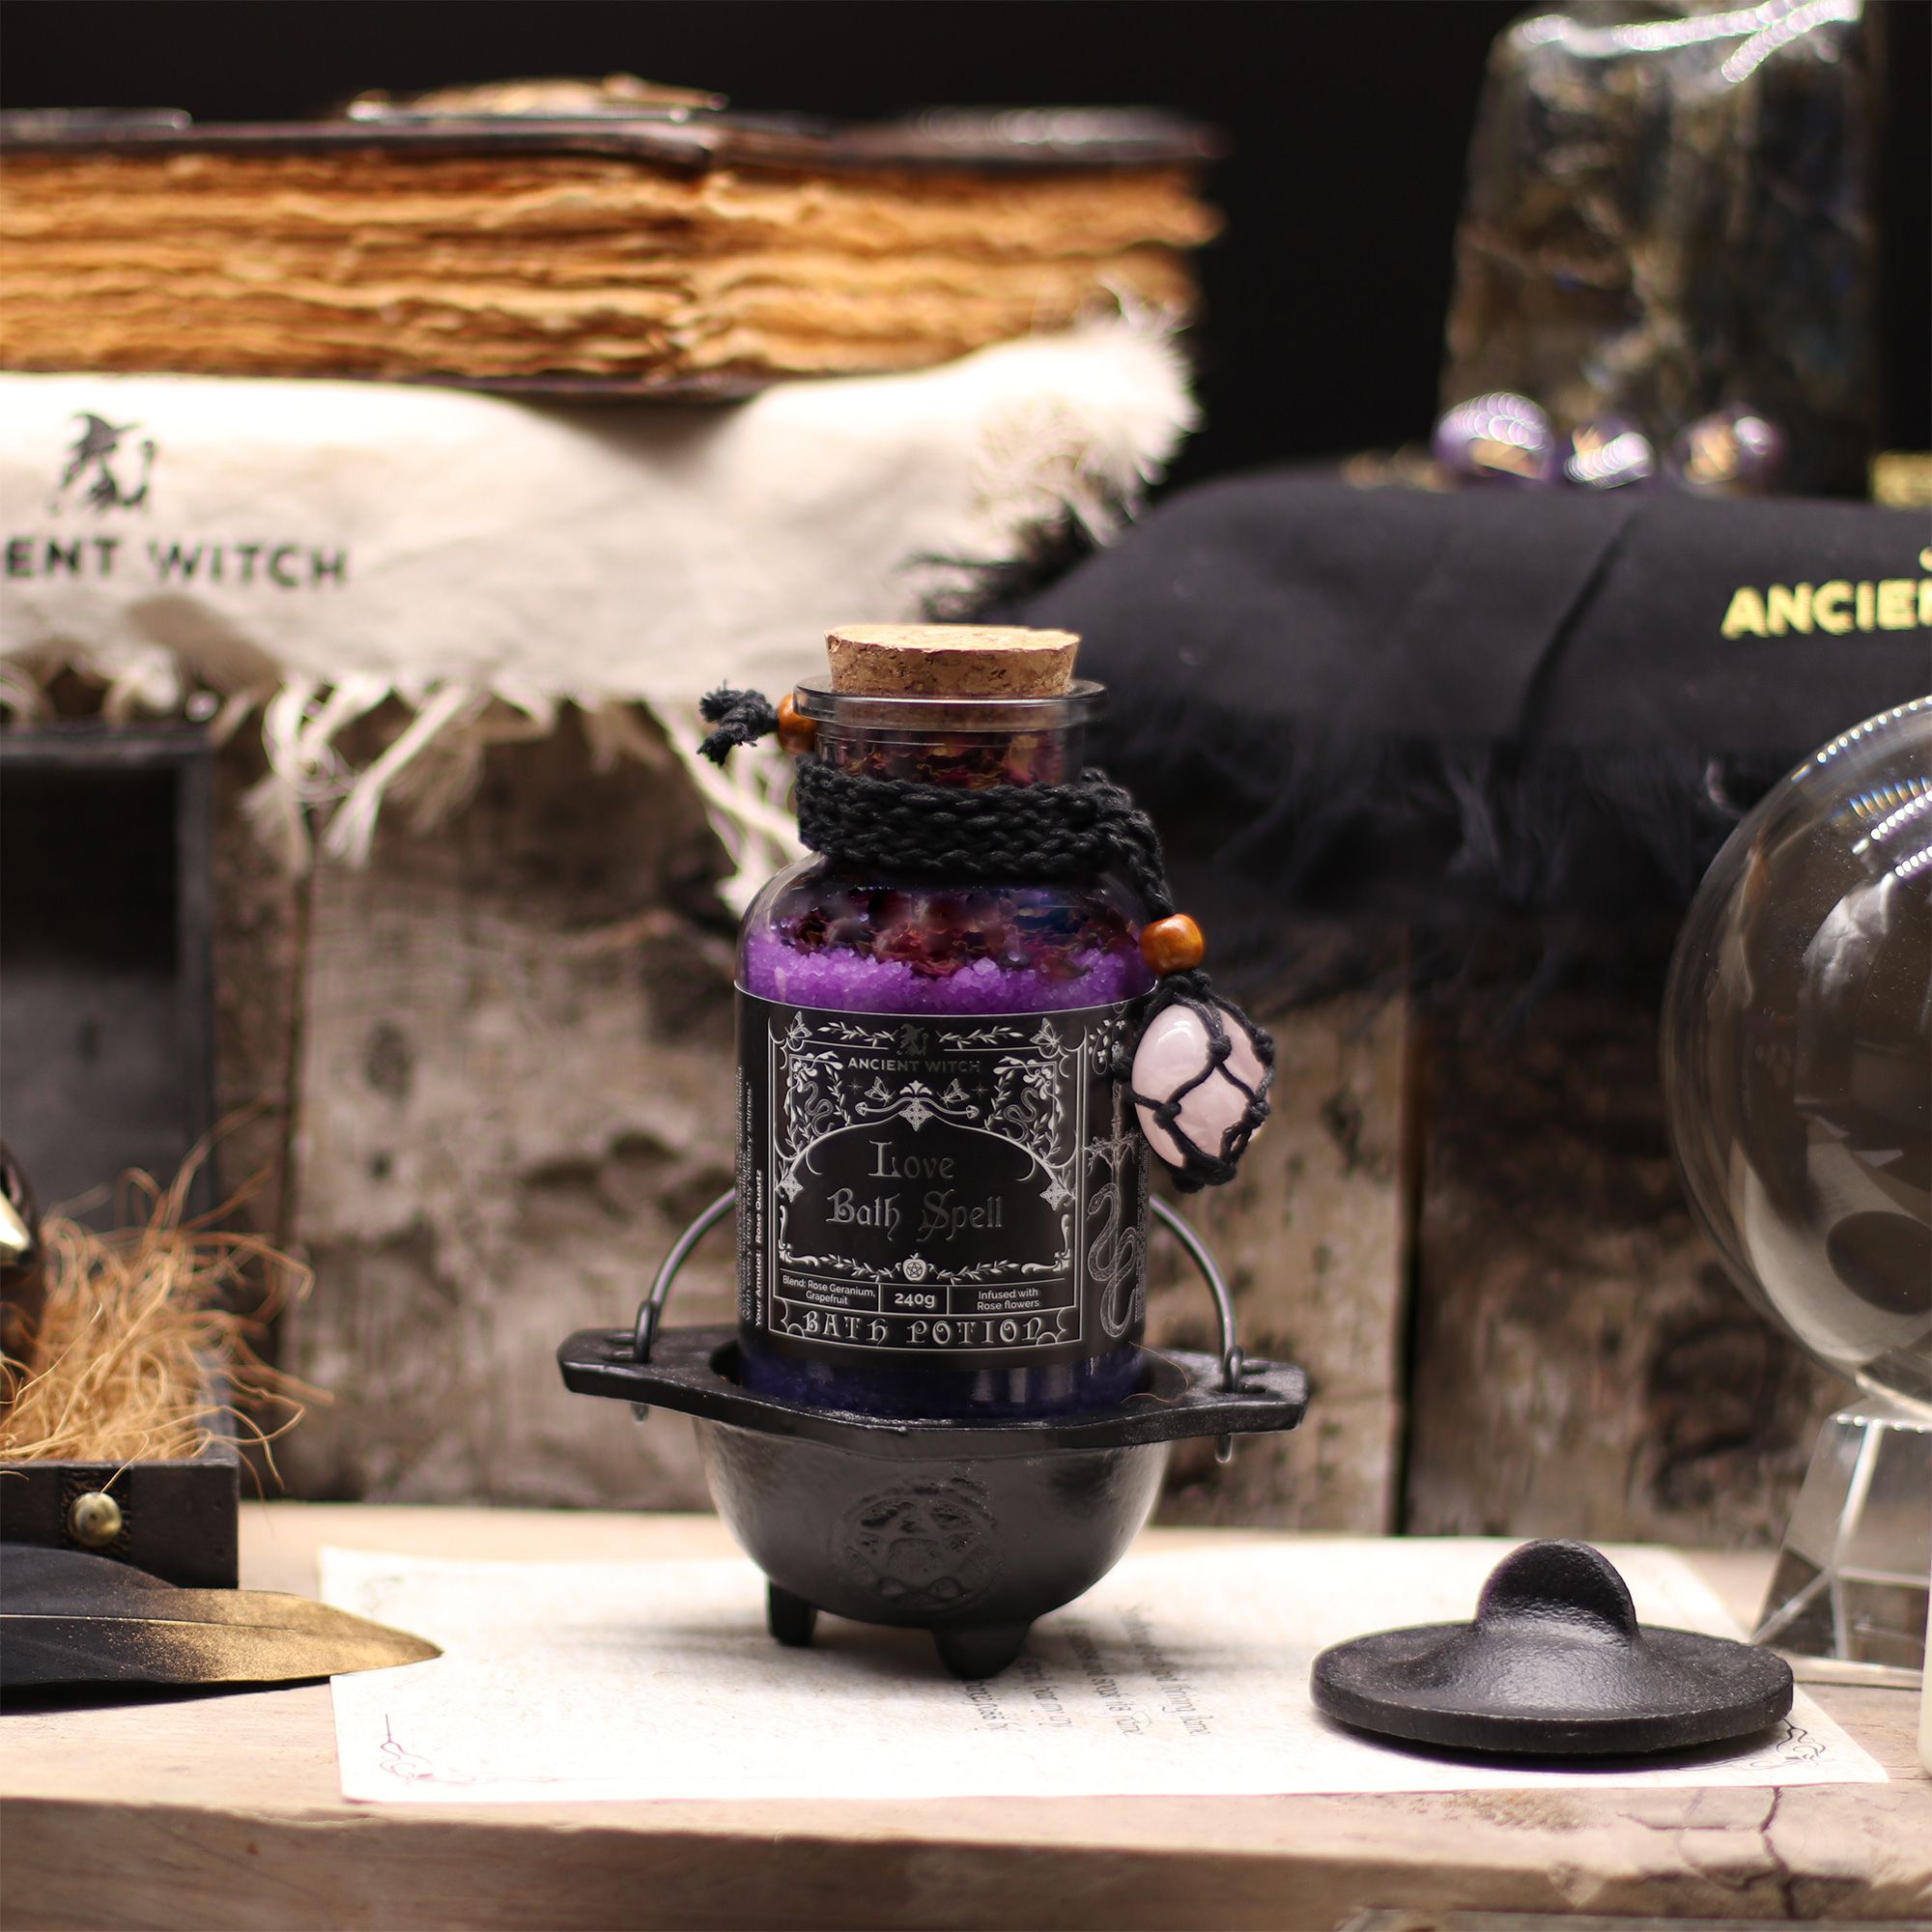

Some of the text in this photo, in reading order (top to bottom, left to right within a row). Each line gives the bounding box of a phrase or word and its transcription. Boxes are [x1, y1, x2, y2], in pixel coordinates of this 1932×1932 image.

[149, 540, 348, 586] WITCH
[847, 1057, 981, 1073] ANCIENT WITCH
[868, 1139, 954, 1179] Love
[754, 1168, 763, 1210] Quartz
[826, 1187, 1002, 1241] Bath Spell
[754, 1213, 763, 1244] Rose
[781, 1274, 876, 1298] Blend: Rose Geranium,
[805, 1290, 848, 1306] Grapefruit
[978, 1287, 1039, 1300] Infused with
[895, 1293, 935, 1308] 240g
[977, 1299, 1040, 1312] Rose flowers
[754, 1301, 763, 1327] Your
[803, 1310, 1042, 1347] BATH POTION
